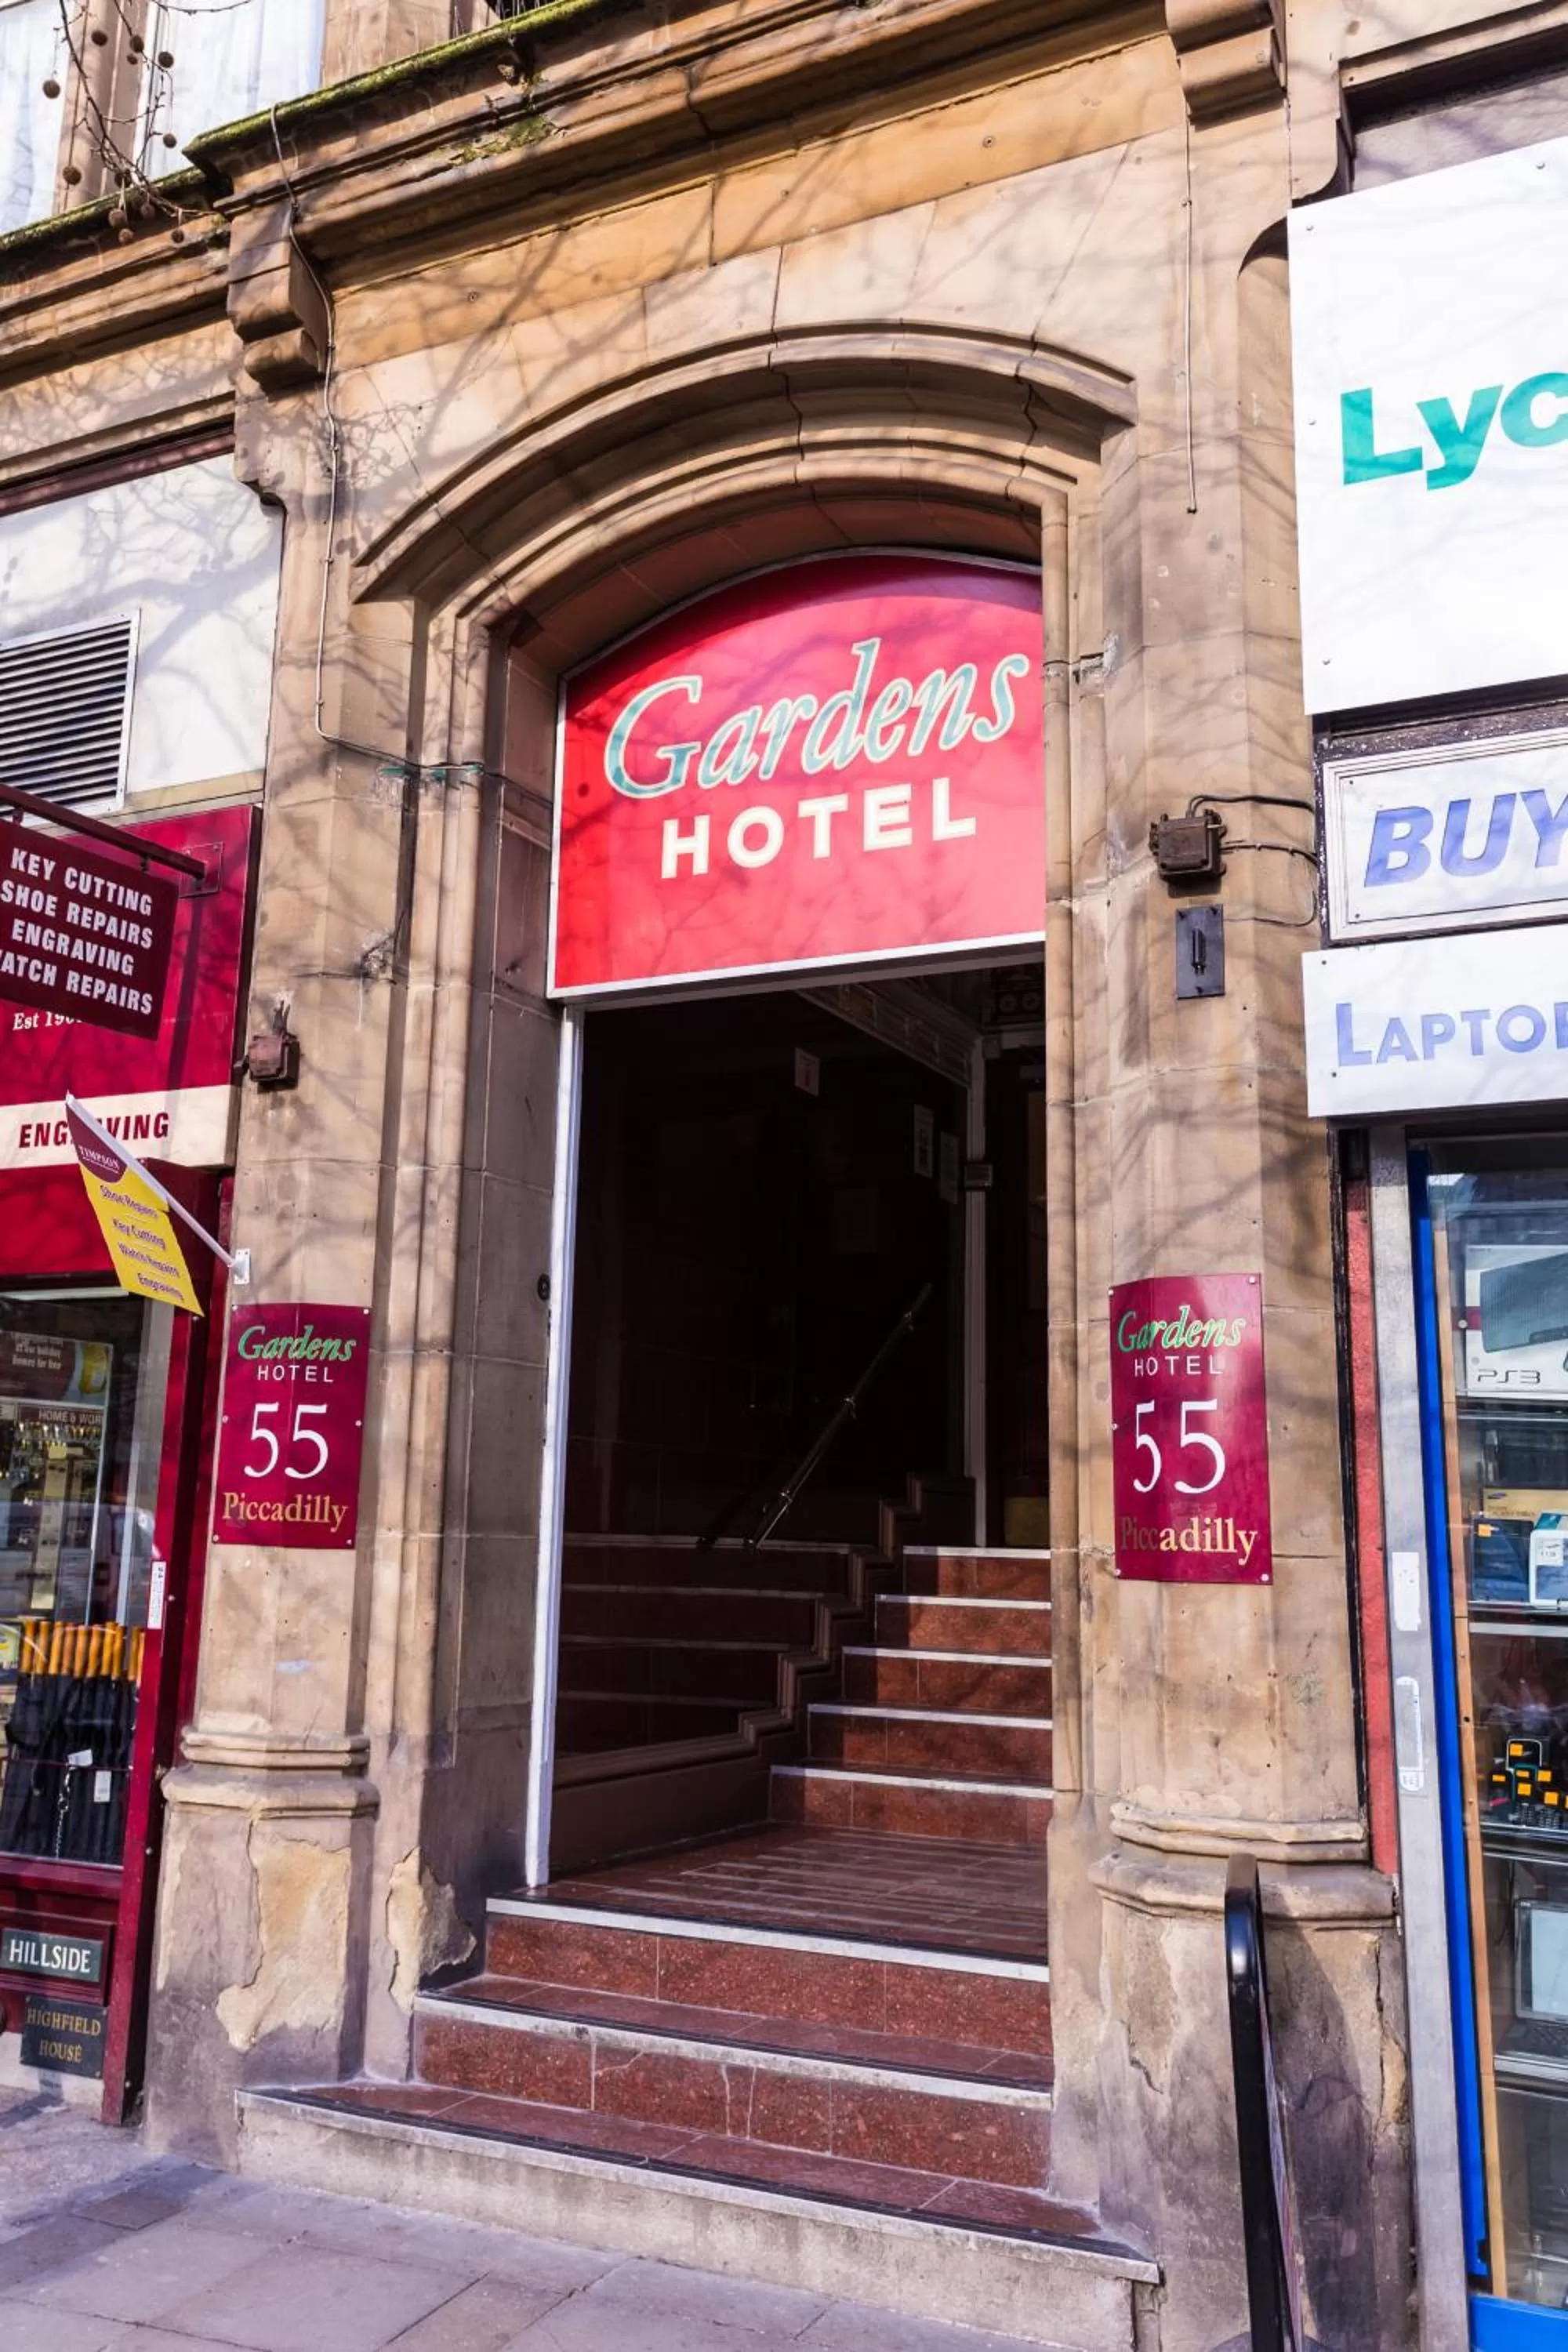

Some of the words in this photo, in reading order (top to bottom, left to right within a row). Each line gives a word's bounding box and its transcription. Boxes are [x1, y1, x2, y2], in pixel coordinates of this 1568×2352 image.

[604, 637, 1029, 800] Gardens
[661, 777, 976, 879] HOTEL
[1363, 790, 1568, 888] BUY
[11, 848, 56, 880] KEY
[64, 866, 152, 916] CUTTING
[1, 880, 58, 917] SHOE
[67, 902, 153, 949] REPAIRS
[12, 919, 134, 976] ENGRAVING
[0, 949, 57, 986] ATCH
[66, 970, 153, 1015] REPAIRS
[13, 1012, 39, 1031] Est
[19, 1112, 169, 1149] ENGVING
[78, 1146, 119, 1168] TIMPSON
[238, 1325, 357, 1362] Gardens
[1118, 1305, 1245, 1352] Gardens
[257, 1365, 333, 1382] HOTEL
[1134, 1355, 1224, 1377] HOTEL
[1477, 1369, 1541, 1385] PS3
[38, 1410, 68, 1423] HOME
[244, 1402, 328, 1479] 55
[1133, 1398, 1225, 1494] 55
[222, 1491, 348, 1532] Piccadilly
[1120, 1516, 1258, 1566] Piccadilly
[9, 1939, 91, 1973] HILLSIDE
[27, 2008, 101, 2036] HIGHFIELD
[40, 2039, 82, 2063] HOUSE
